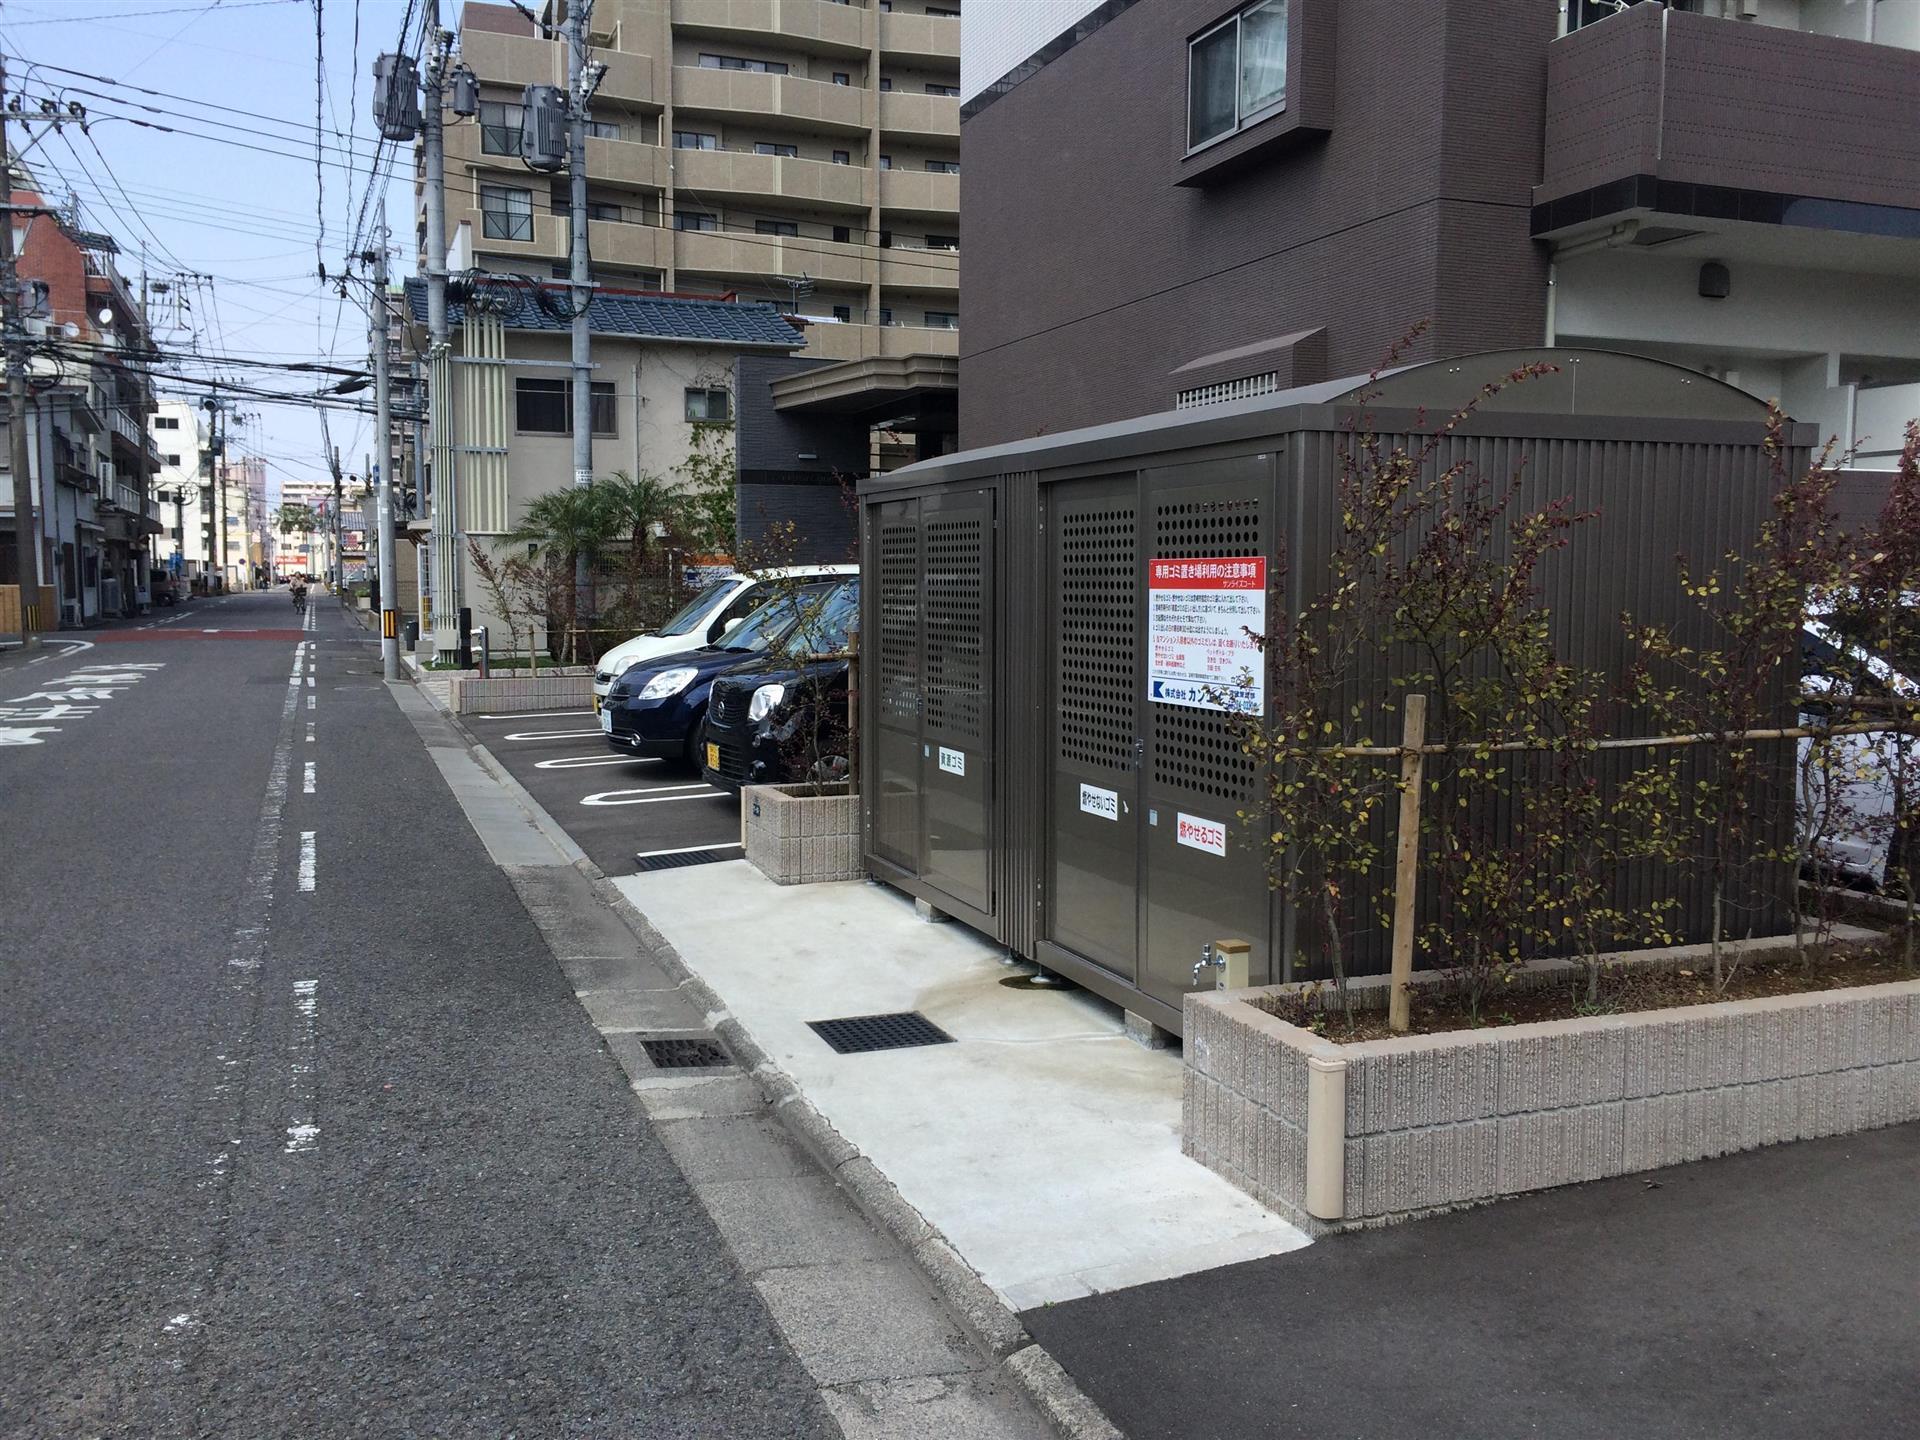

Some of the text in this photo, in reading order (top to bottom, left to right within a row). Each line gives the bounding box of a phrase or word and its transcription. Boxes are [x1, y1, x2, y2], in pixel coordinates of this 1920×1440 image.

[1155, 563, 1256, 579] 専用ゴミ置き場利用の注意事項
[1165, 687, 1187, 700] 株式会社
[1082, 790, 1116, 814] 燃やせないゴミ
[1179, 820, 1223, 848] 燃やせるゴミ
